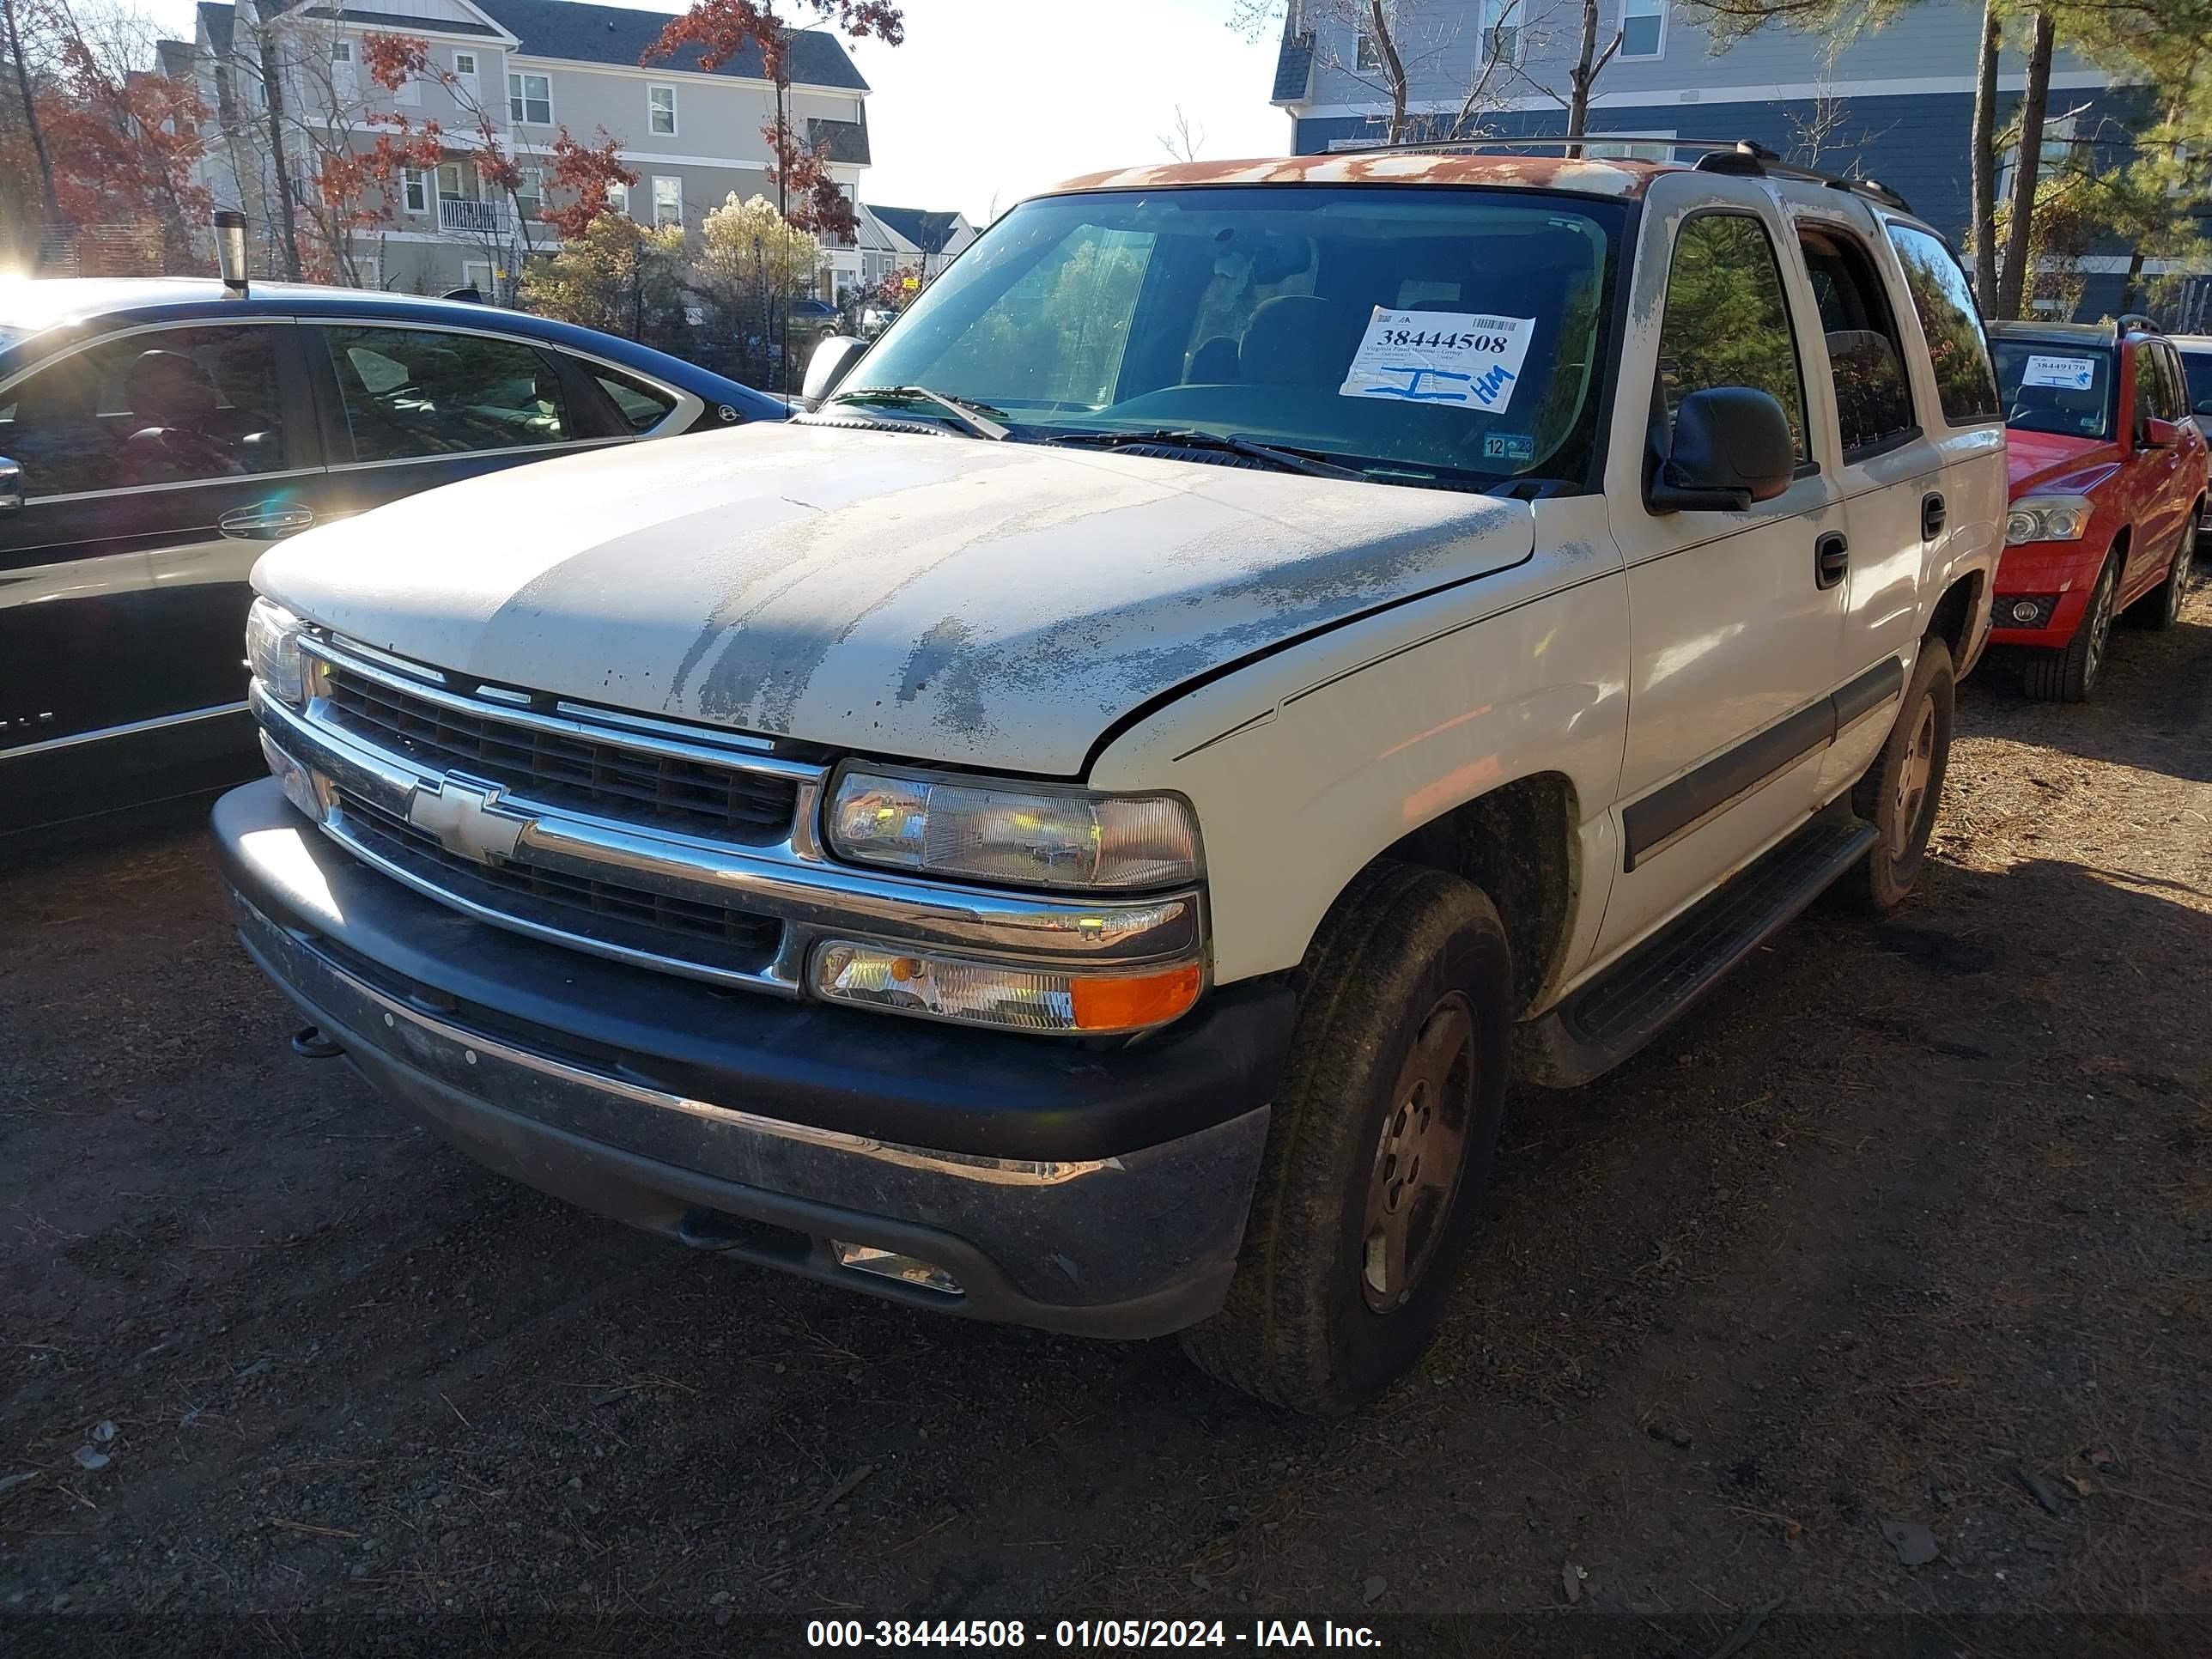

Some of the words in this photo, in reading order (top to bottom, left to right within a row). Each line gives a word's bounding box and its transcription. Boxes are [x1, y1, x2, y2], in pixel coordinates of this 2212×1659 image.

[1376, 329, 1509, 354] 38444508
[2034, 362, 2086, 371] 38449170
[1487, 439, 1504, 454] 12
[1518, 441, 1533, 453] 23
